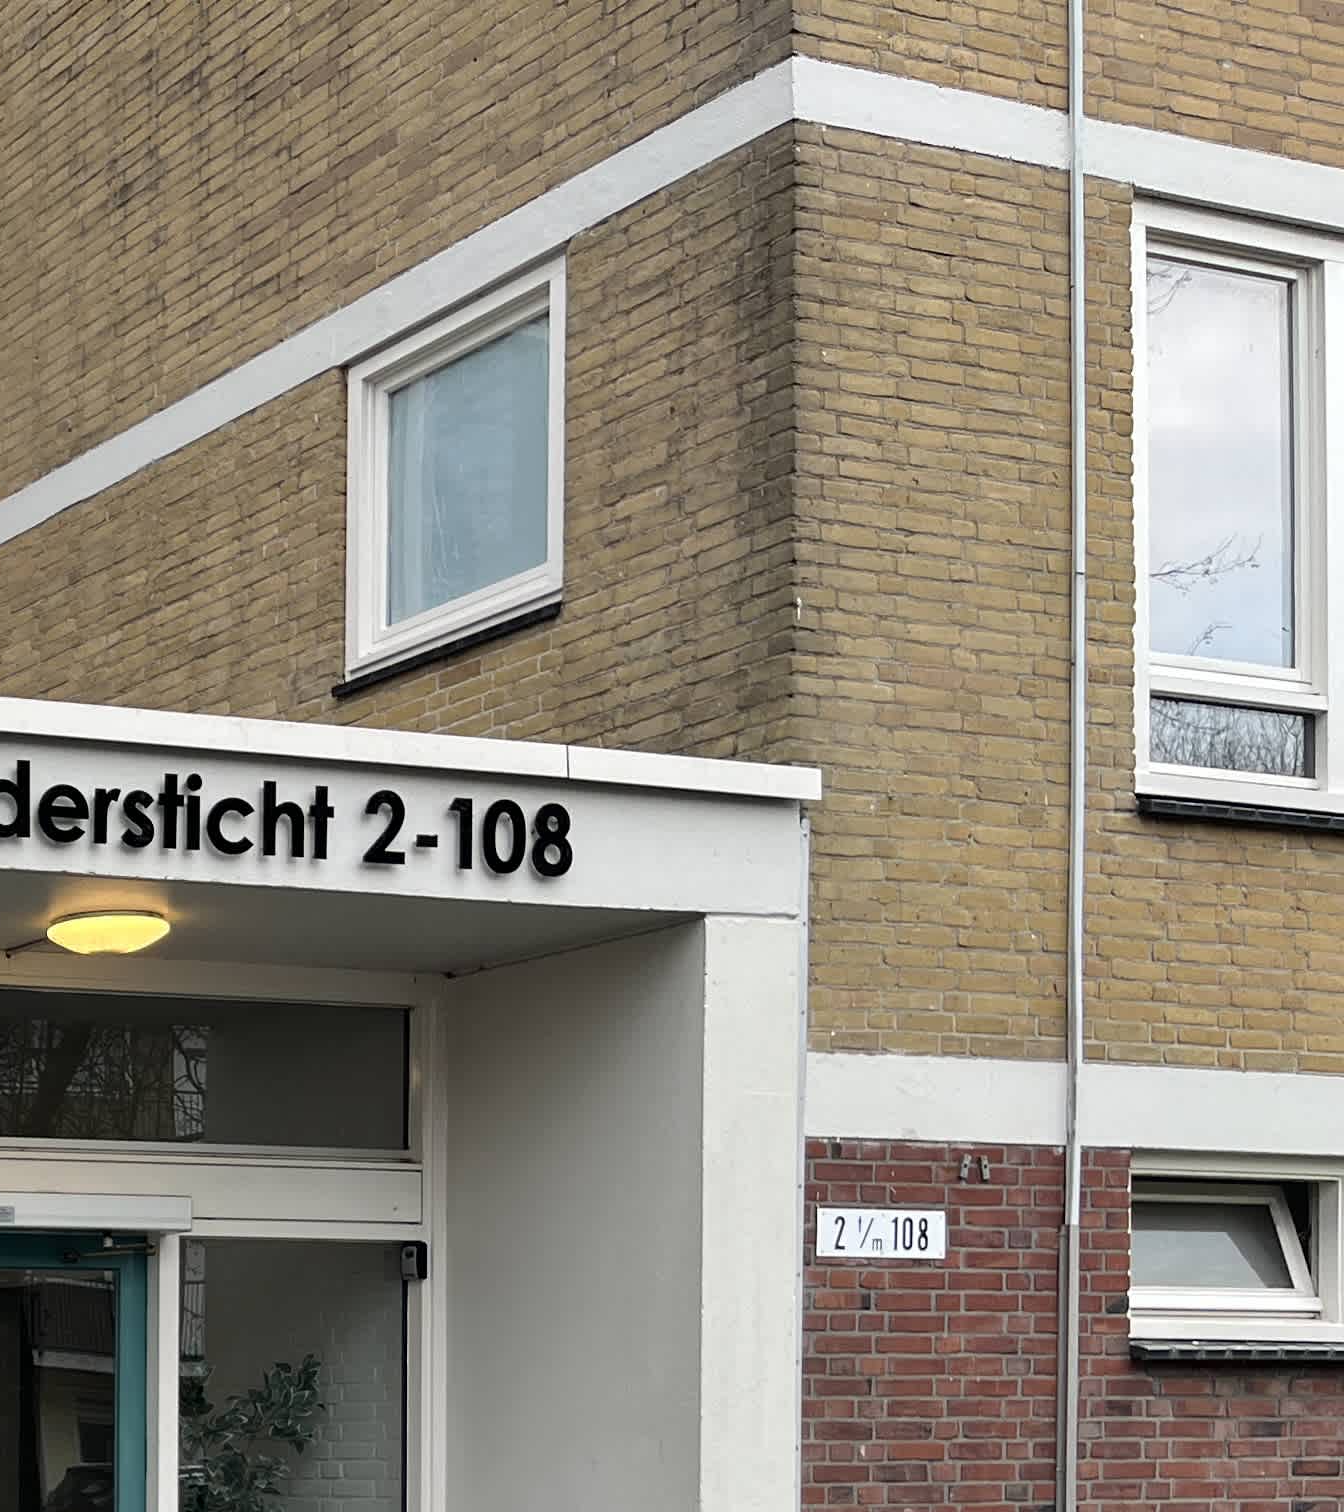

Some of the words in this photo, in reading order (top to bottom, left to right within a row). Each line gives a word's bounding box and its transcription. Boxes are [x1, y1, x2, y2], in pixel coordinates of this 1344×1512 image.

[362, 788, 574, 878] 2-108
[833, 1215, 847, 1251] 2
[891, 1216, 929, 1252] 108
